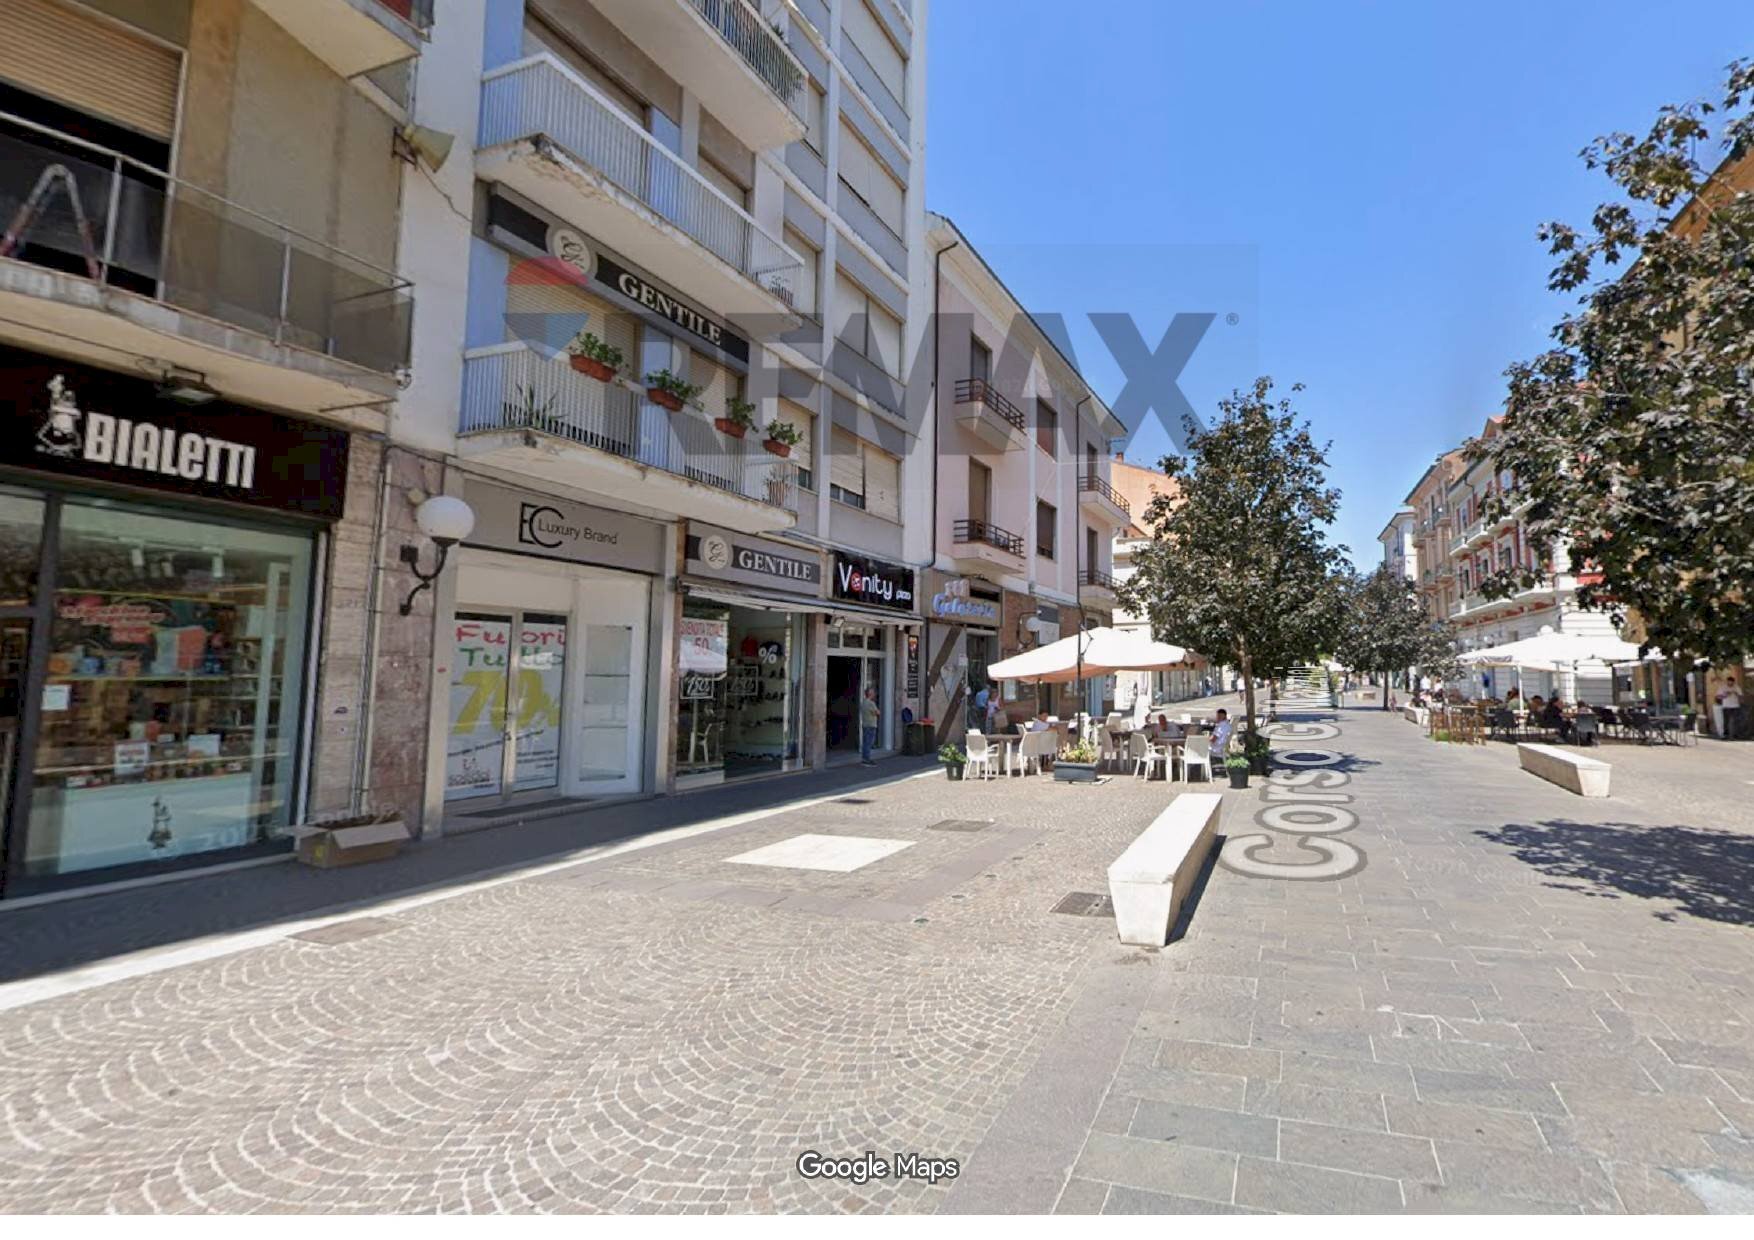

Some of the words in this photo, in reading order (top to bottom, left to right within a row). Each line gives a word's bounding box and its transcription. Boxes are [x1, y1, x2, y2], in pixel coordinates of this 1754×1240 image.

[618, 272, 721, 346] GENTILE
[538, 518, 580, 540] Luxury
[583, 526, 618, 545] Brand
[738, 550, 812, 580] GENTILE
